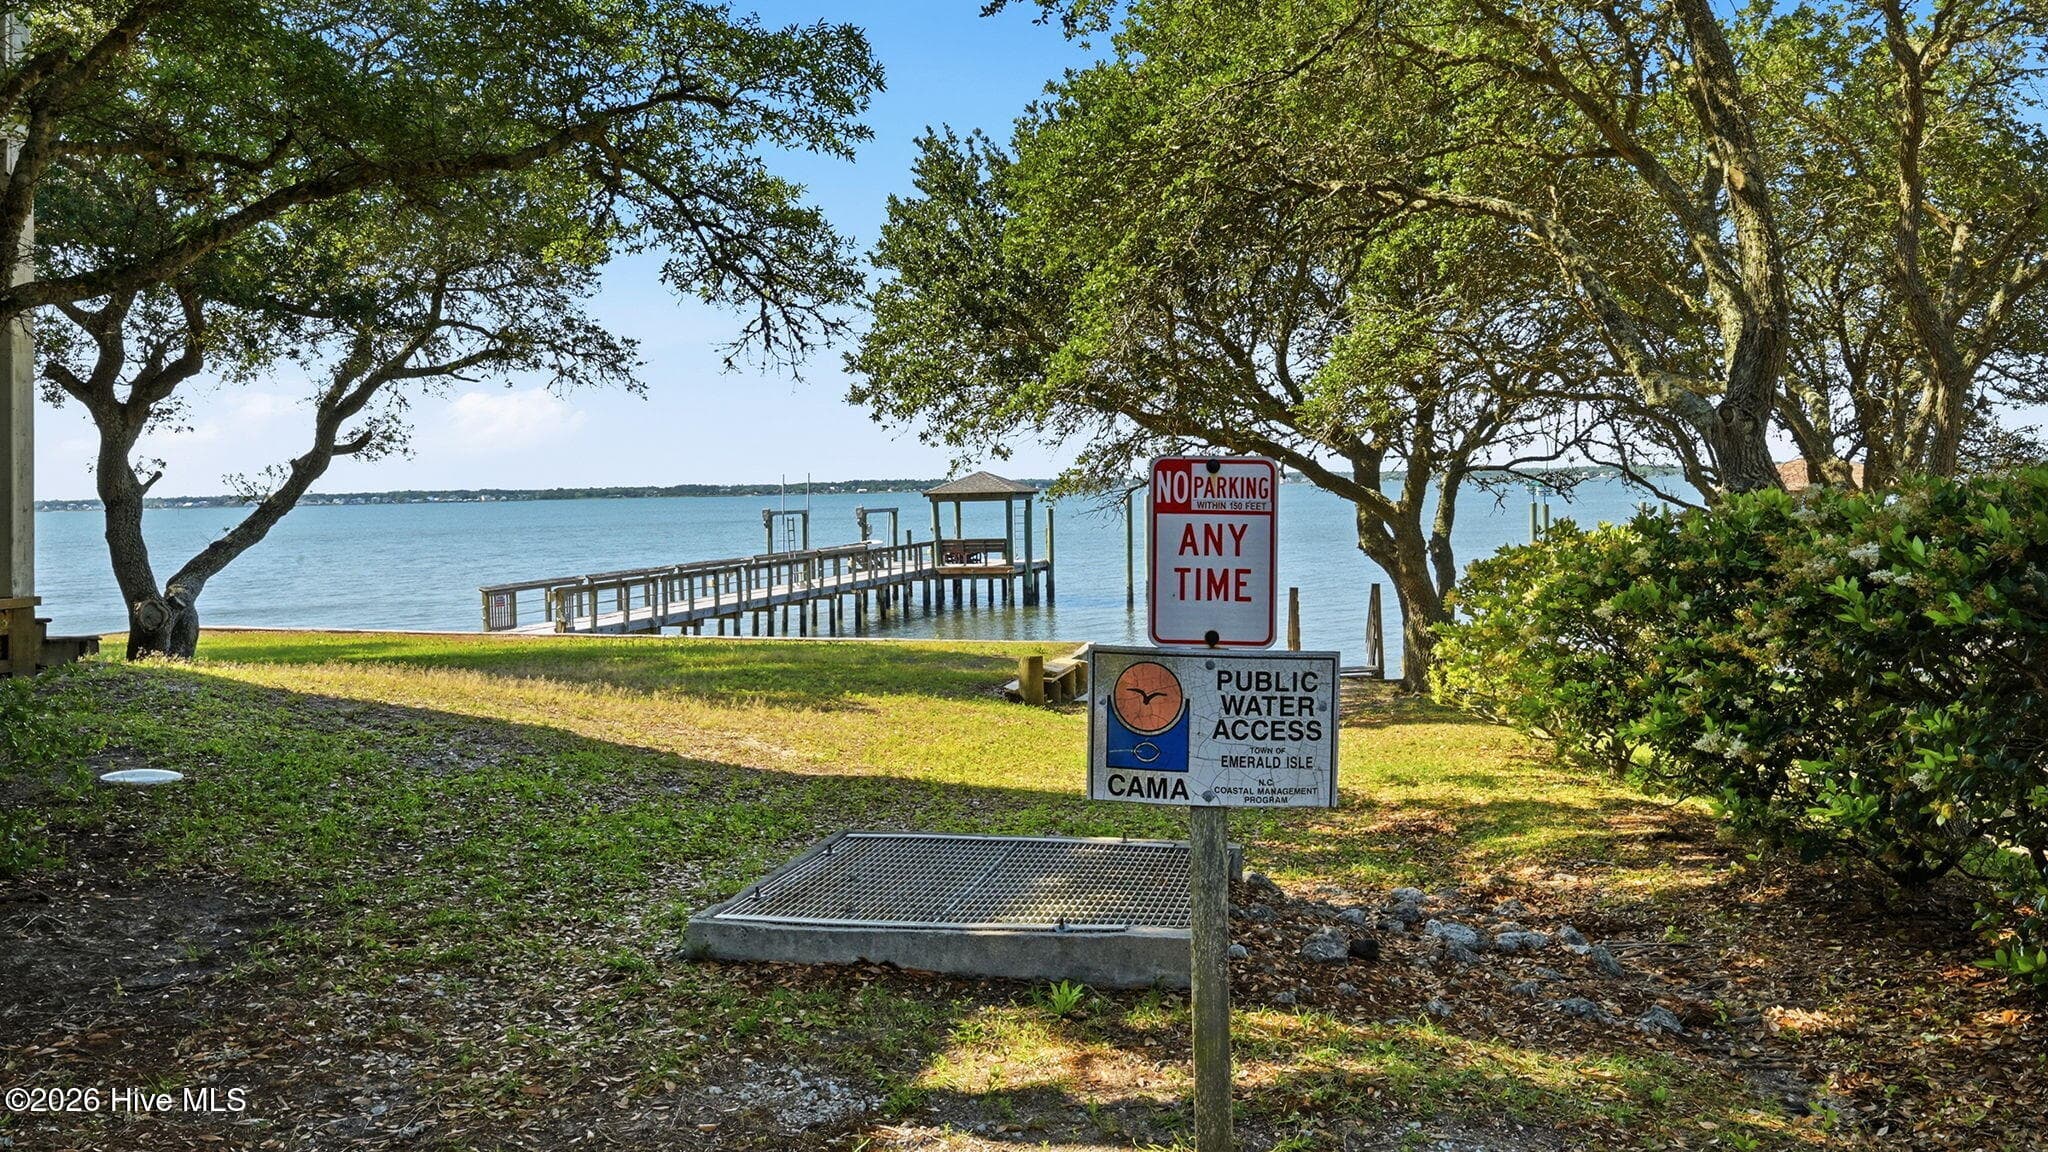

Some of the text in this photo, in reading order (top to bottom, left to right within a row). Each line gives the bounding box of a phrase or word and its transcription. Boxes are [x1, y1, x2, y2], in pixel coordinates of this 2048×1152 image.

[1156, 470, 1269, 503] NO PARKING
[1197, 501, 1266, 510] WITHIN 150 FEET
[1178, 523, 1248, 556] ANY
[1174, 568, 1251, 601] TIME
[1217, 670, 1318, 692] PUBLIC
[1221, 695, 1315, 716] WATER
[1212, 719, 1322, 741] ACCESS
[1221, 755, 1313, 769] EMERALD ISLE
[1107, 774, 1190, 800] CAMA
[1214, 786, 1318, 795] COASTAL MANAGEMENT
[1244, 796, 1288, 804] PROGRAM
